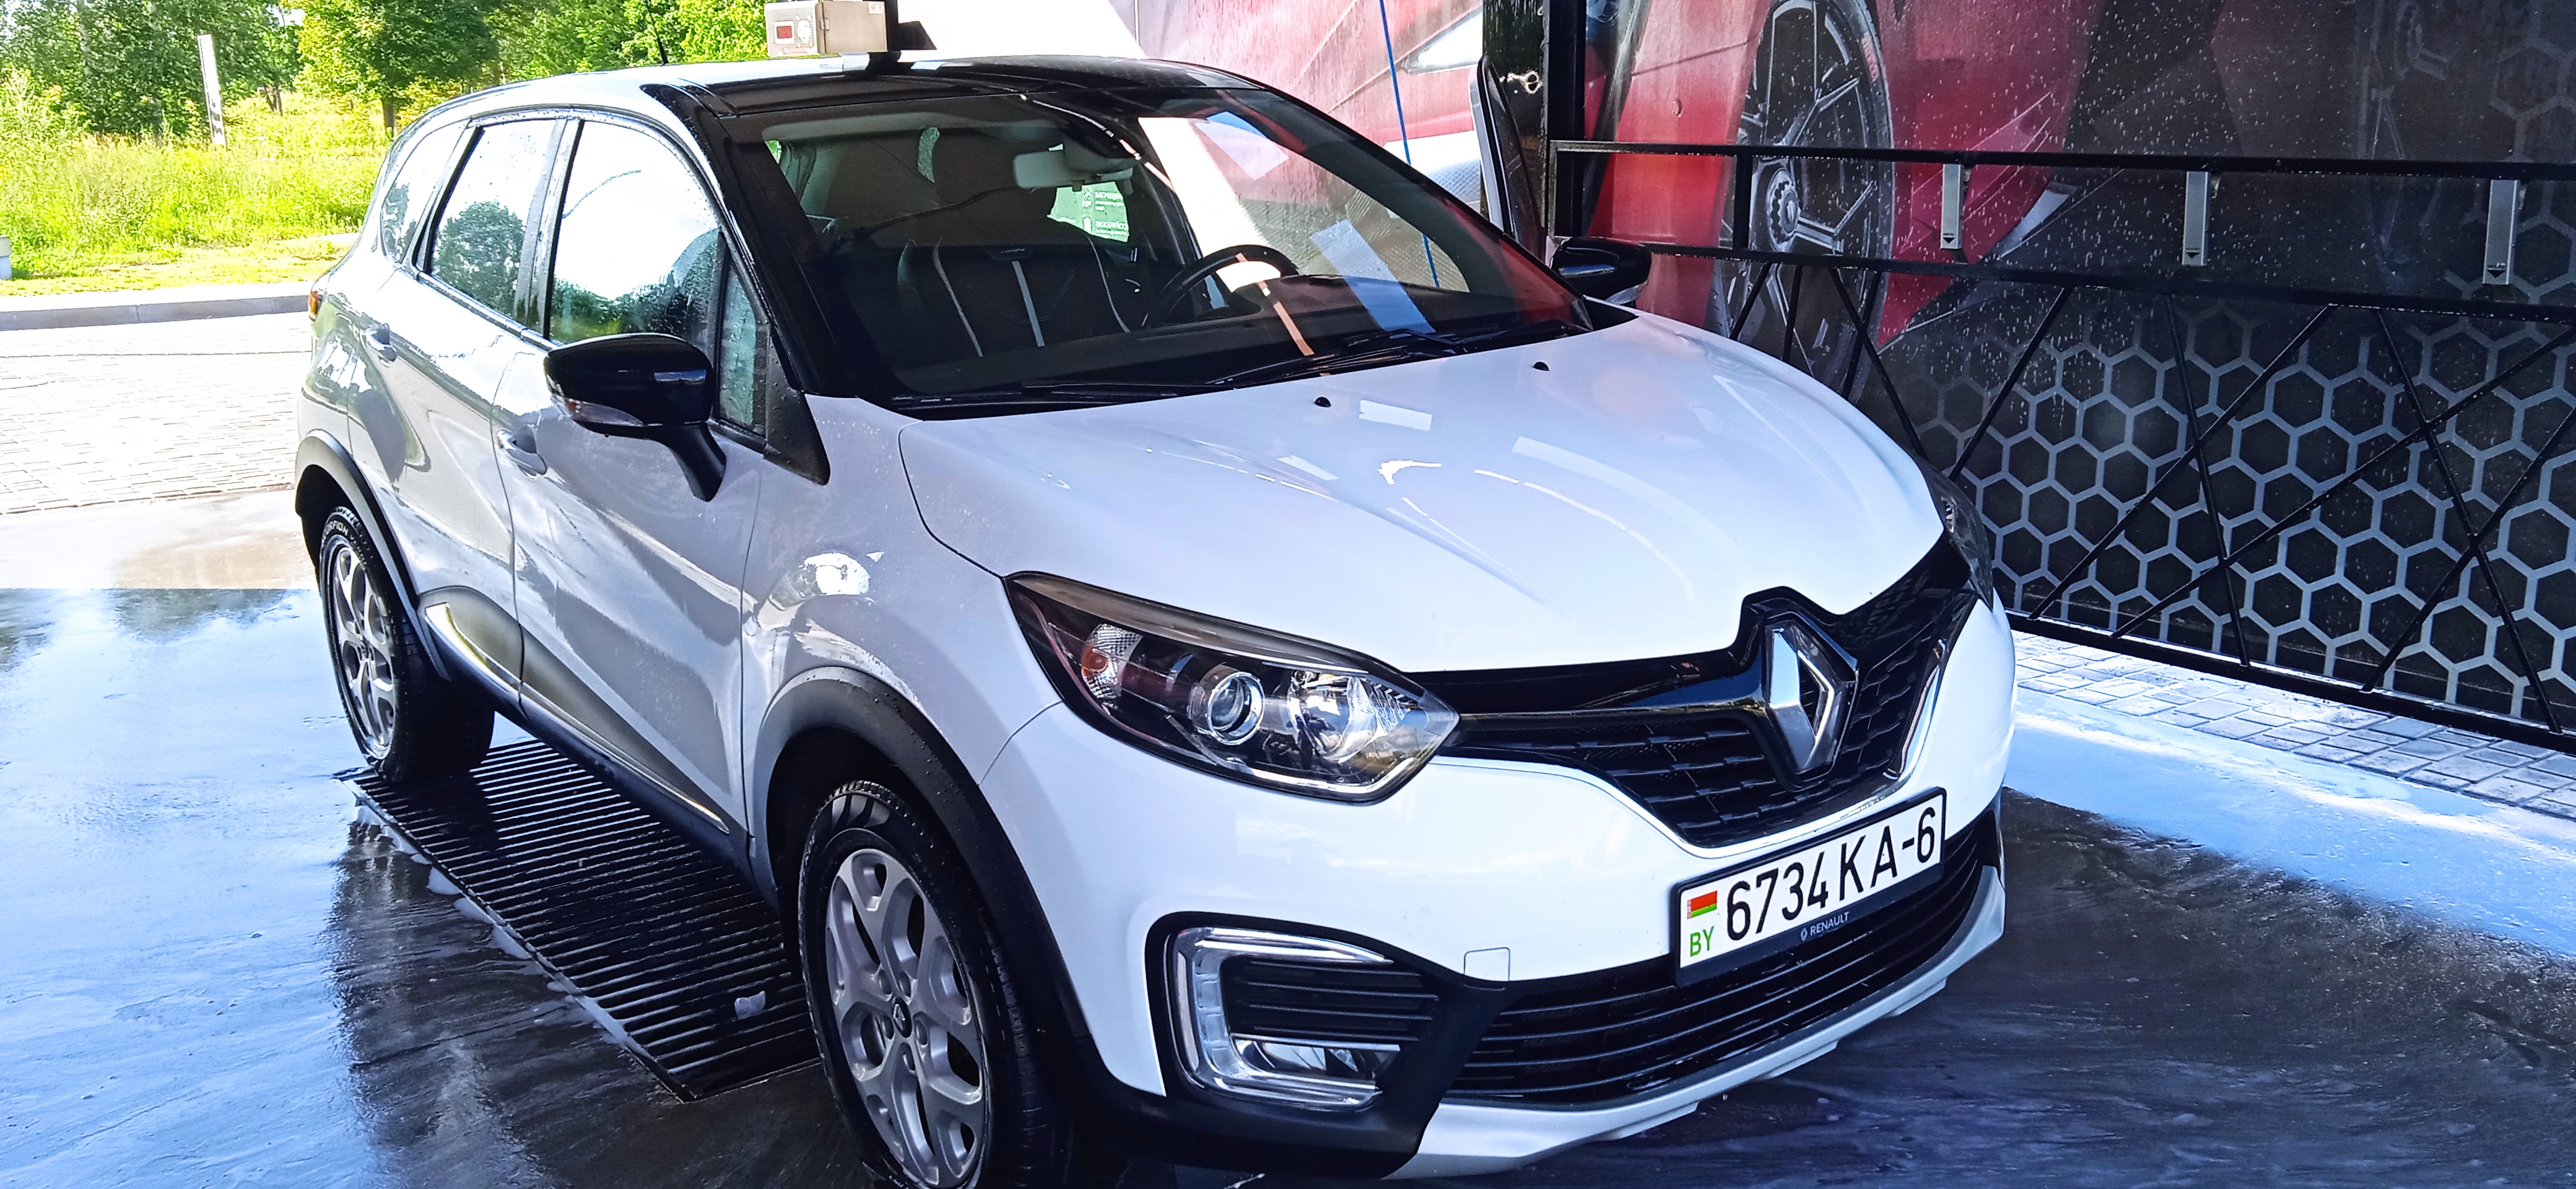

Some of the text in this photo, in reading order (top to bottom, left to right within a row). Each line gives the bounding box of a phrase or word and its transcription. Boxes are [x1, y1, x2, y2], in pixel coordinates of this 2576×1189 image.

[1726, 807, 1936, 941] 6734 KA-6
[1810, 911, 1850, 936] RENAULT
[1689, 926, 1715, 957] BY
